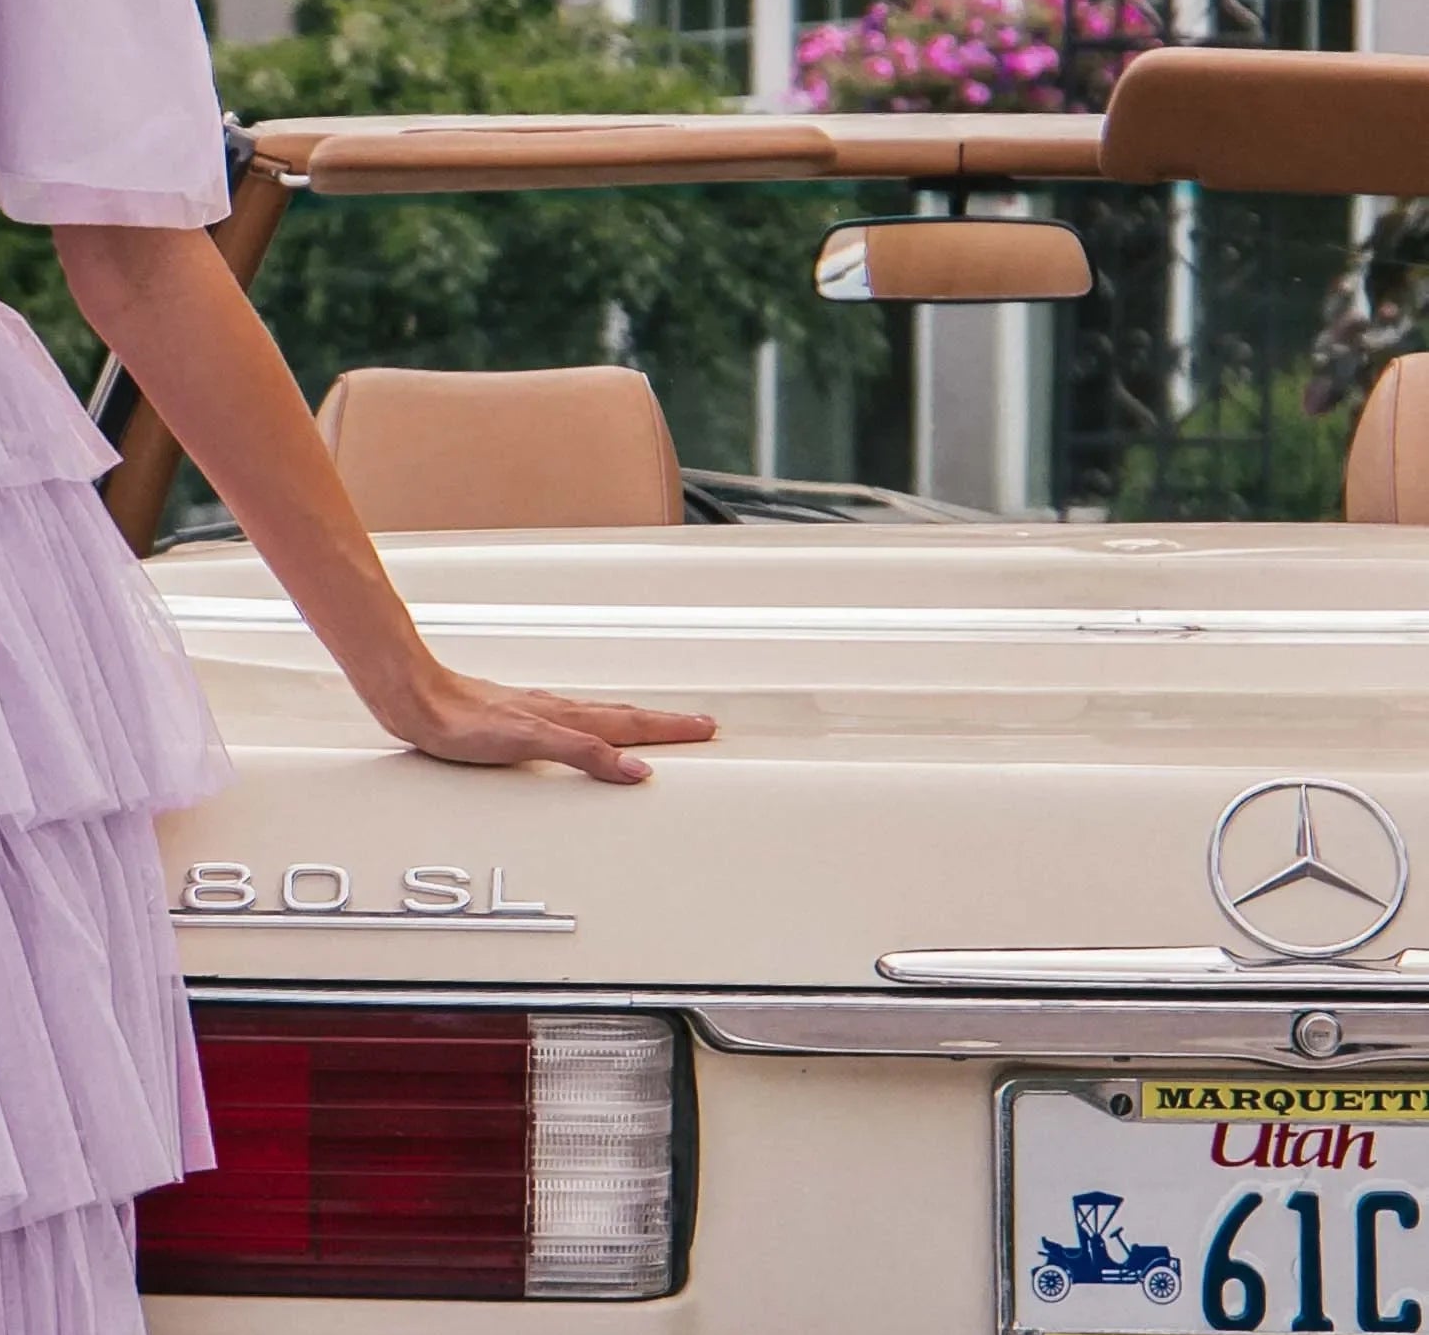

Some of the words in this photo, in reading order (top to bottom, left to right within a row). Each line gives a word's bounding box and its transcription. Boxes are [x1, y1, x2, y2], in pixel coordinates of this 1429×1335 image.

[181, 862, 352, 911] 80
[401, 866, 546, 914] SL
[1156, 1088, 1429, 1115] MARQUETT
[1210, 1123, 1377, 1170] Utah
[1202, 1191, 1422, 1333] 61C
